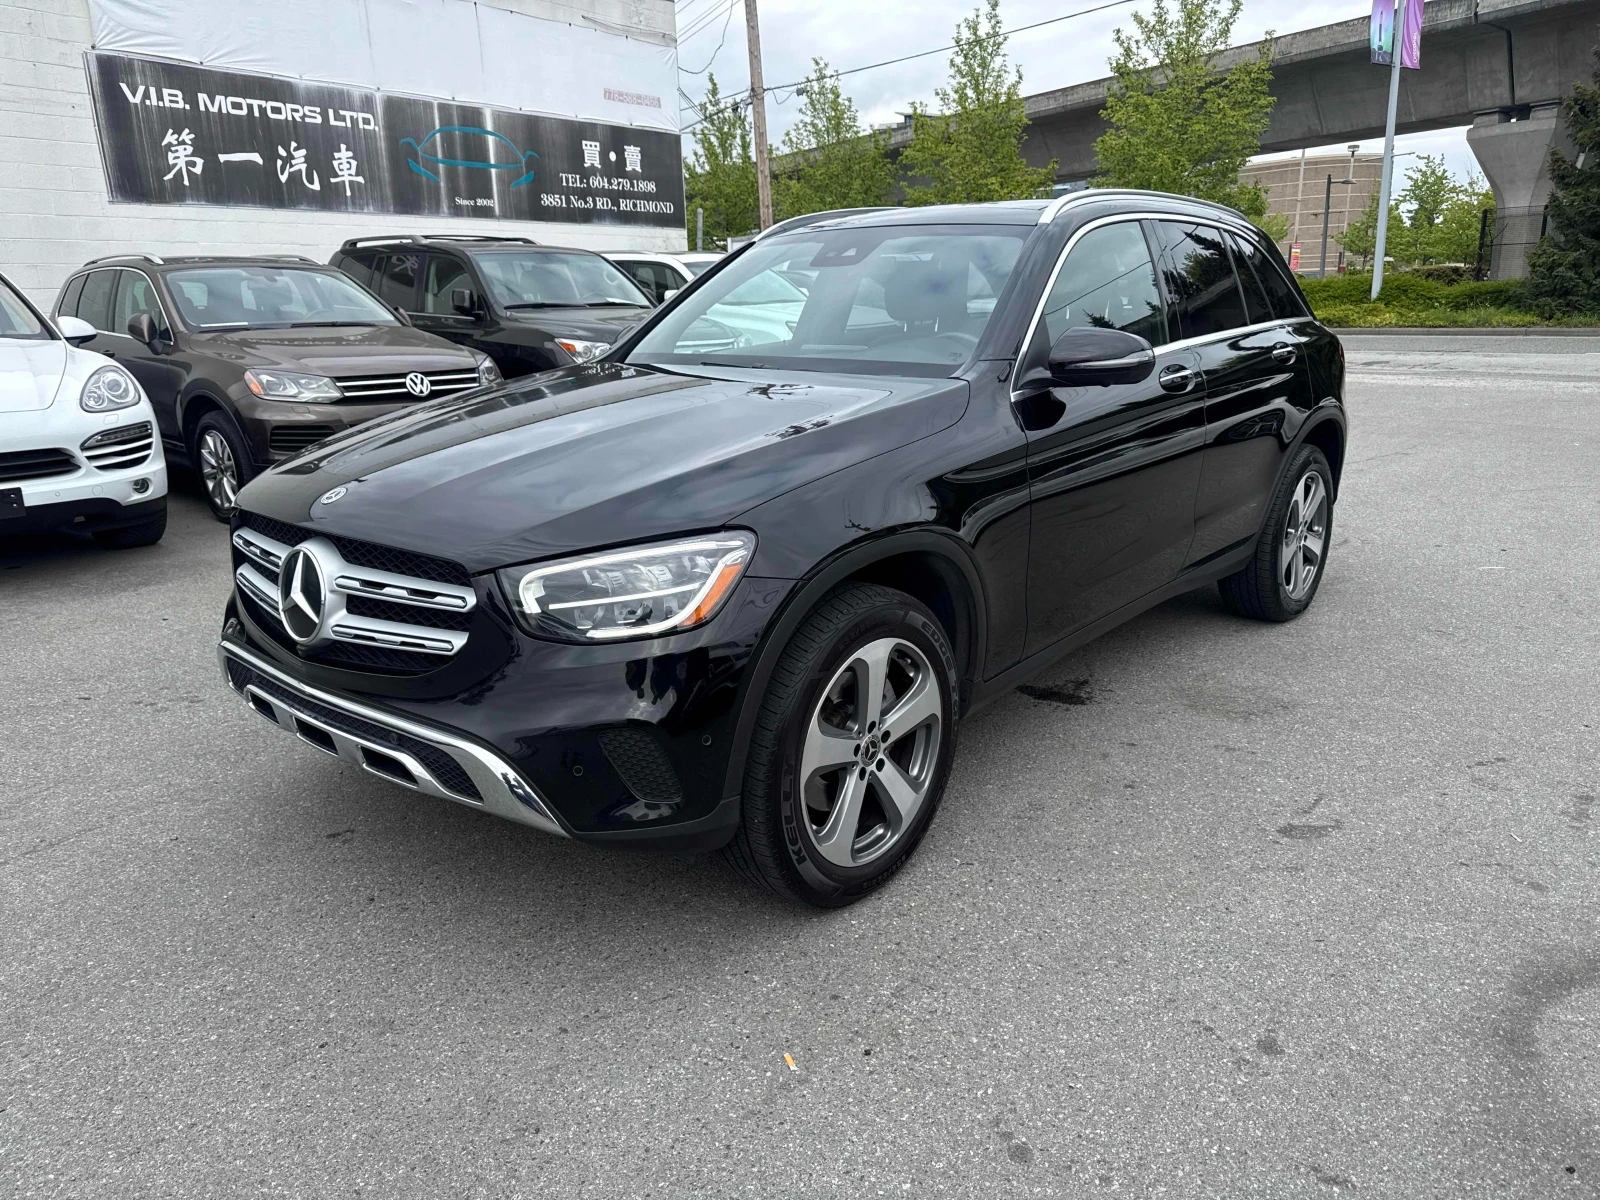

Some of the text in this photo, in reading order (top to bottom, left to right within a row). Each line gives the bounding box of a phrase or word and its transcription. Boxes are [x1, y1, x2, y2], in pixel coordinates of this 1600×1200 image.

[119, 82, 379, 131] V.I.B. MOTORS LTD.
[161, 127, 365, 197] 第一汽車
[559, 172, 656, 194] TEL: 604.279.1898
[455, 196, 494, 207] Since 2002
[540, 193, 674, 214] 3851 No.3 RD., RICHMOND
[782, 752, 808, 866] KELLY
